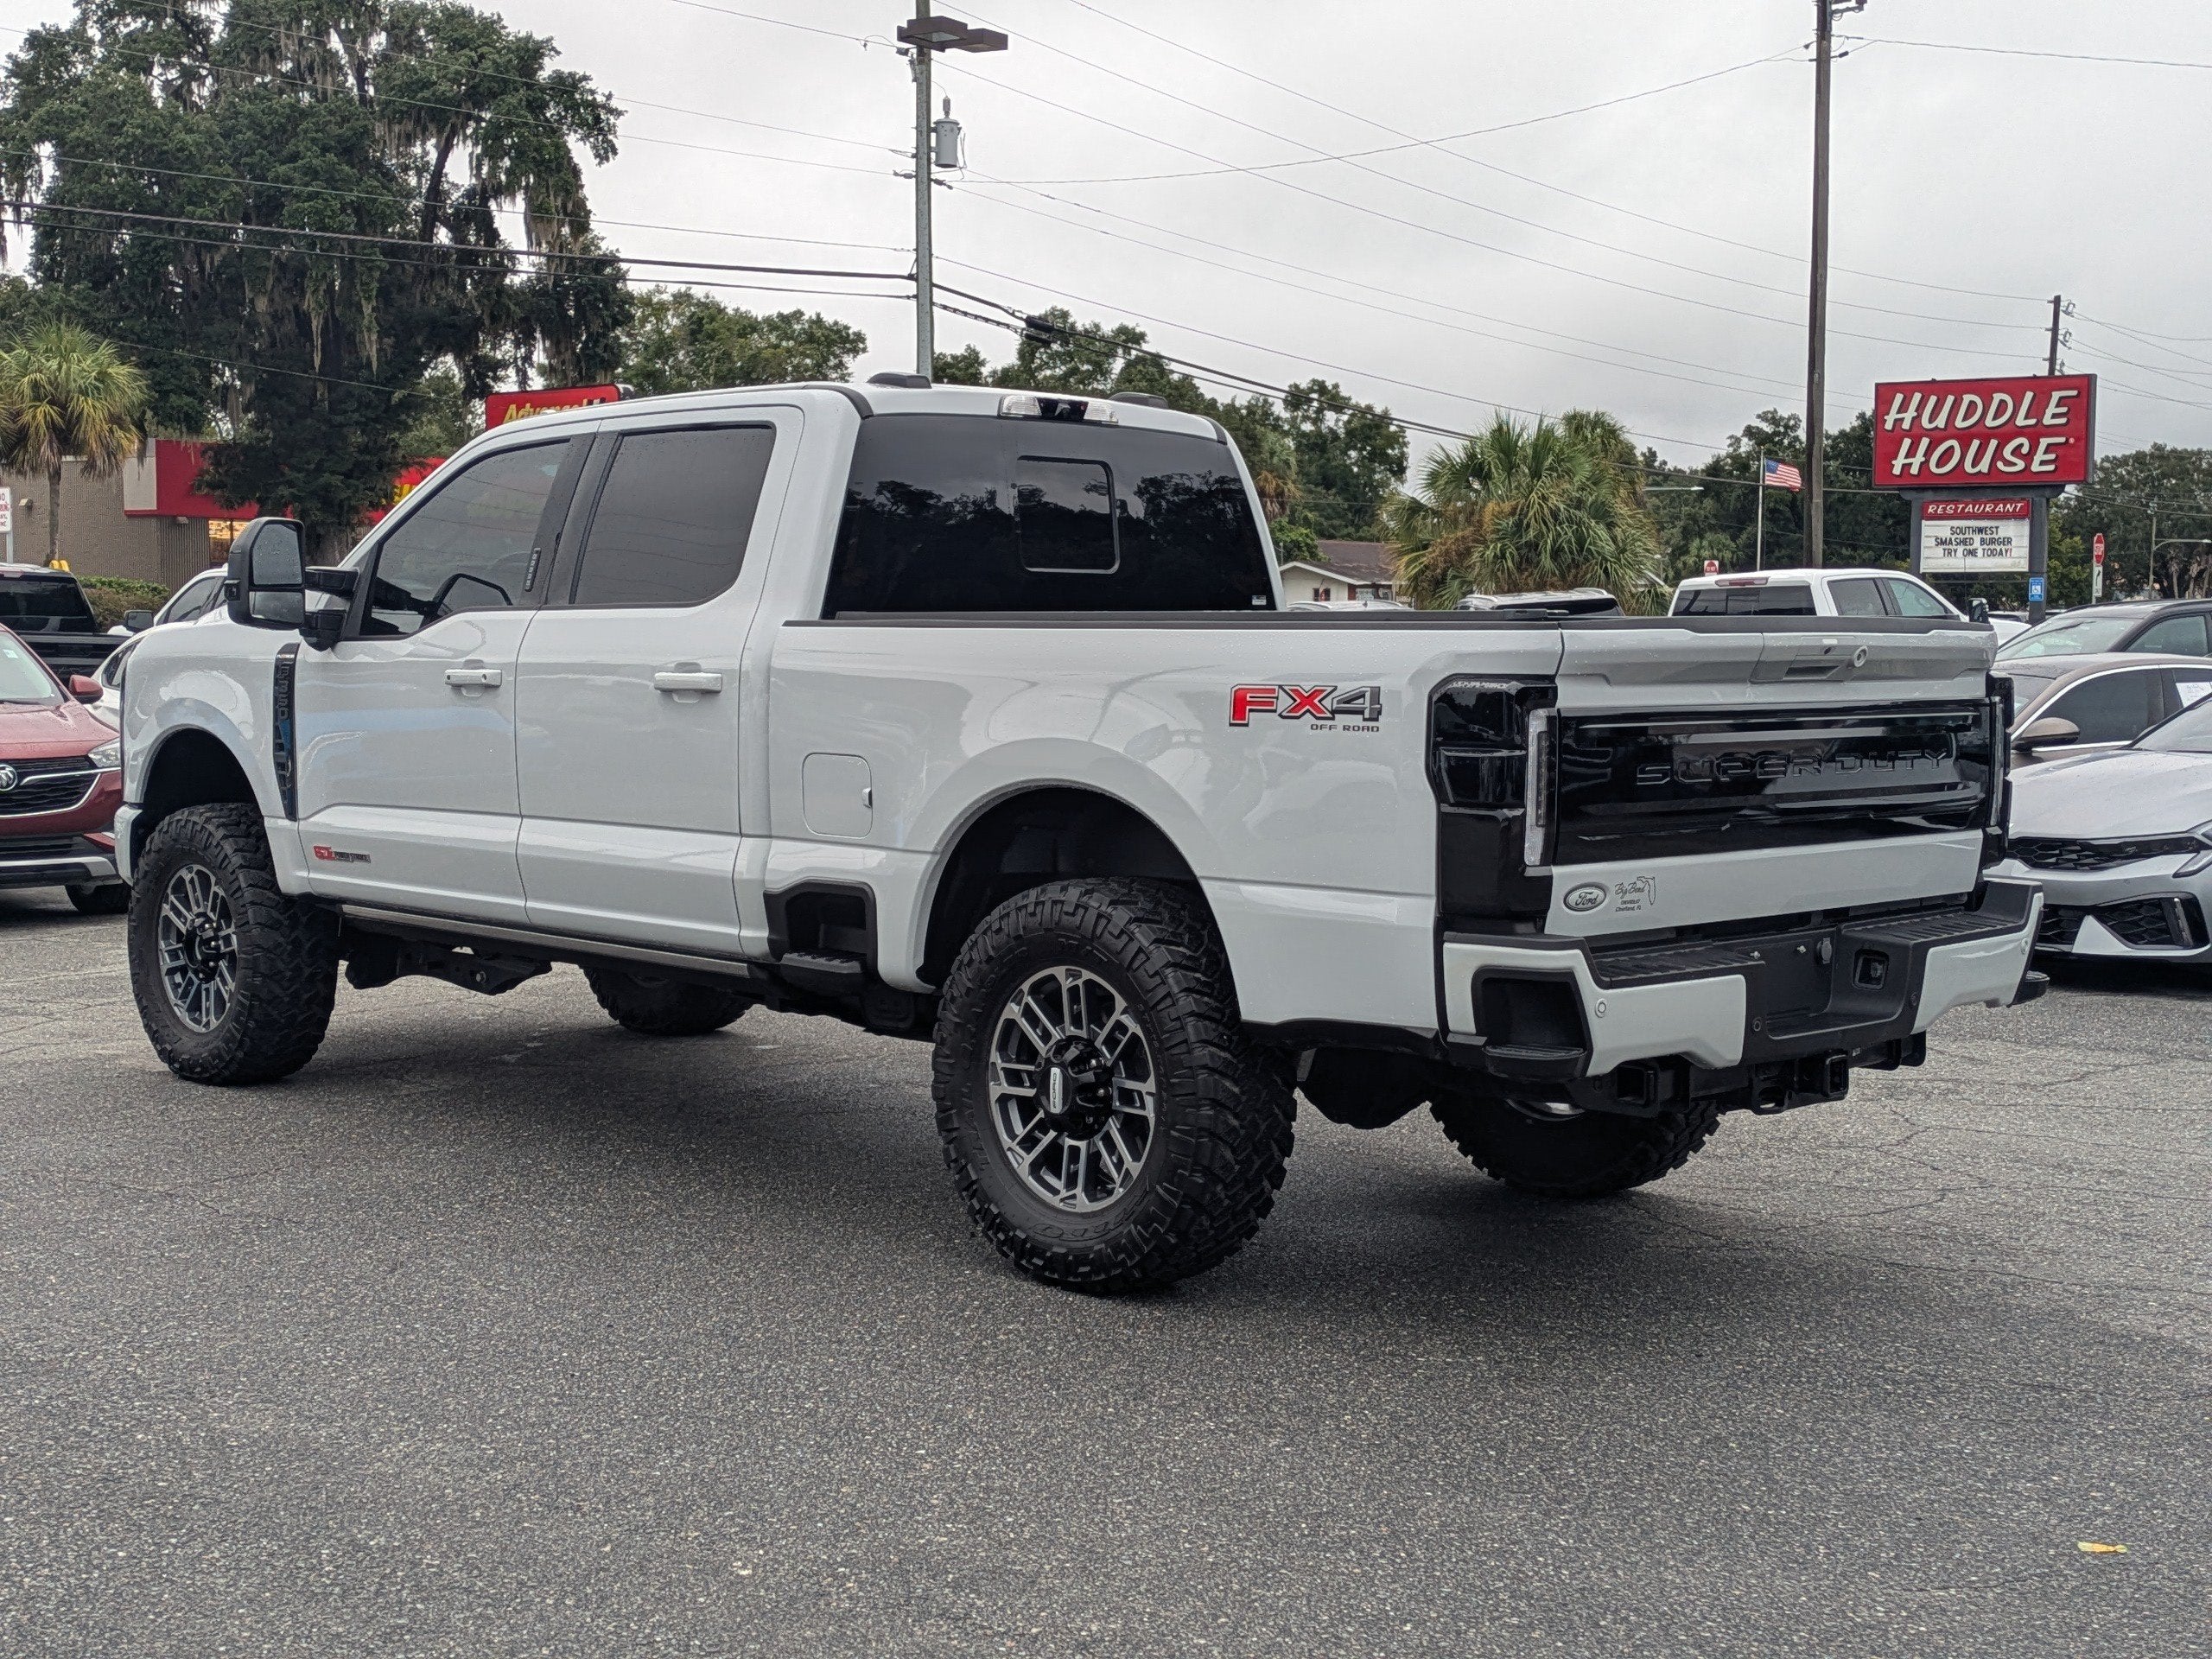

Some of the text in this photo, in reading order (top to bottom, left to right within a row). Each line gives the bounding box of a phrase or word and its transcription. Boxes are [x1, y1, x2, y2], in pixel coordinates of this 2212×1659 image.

[1884, 390, 2078, 431] HUDDLE
[1891, 436, 2067, 475] HOUSE
[1927, 503, 2024, 515] RESTAURANT
[1949, 525, 1999, 536] SOUTHWEST
[1935, 537, 2012, 547] SMASHED BURGER
[1942, 548, 2012, 558] TRY ONE TODAY!
[1229, 683, 1382, 728] FX4
[1342, 724, 1380, 733] ROAD
[1637, 747, 1948, 785] SUPER DUTY
[1574, 891, 1599, 906] Ford
